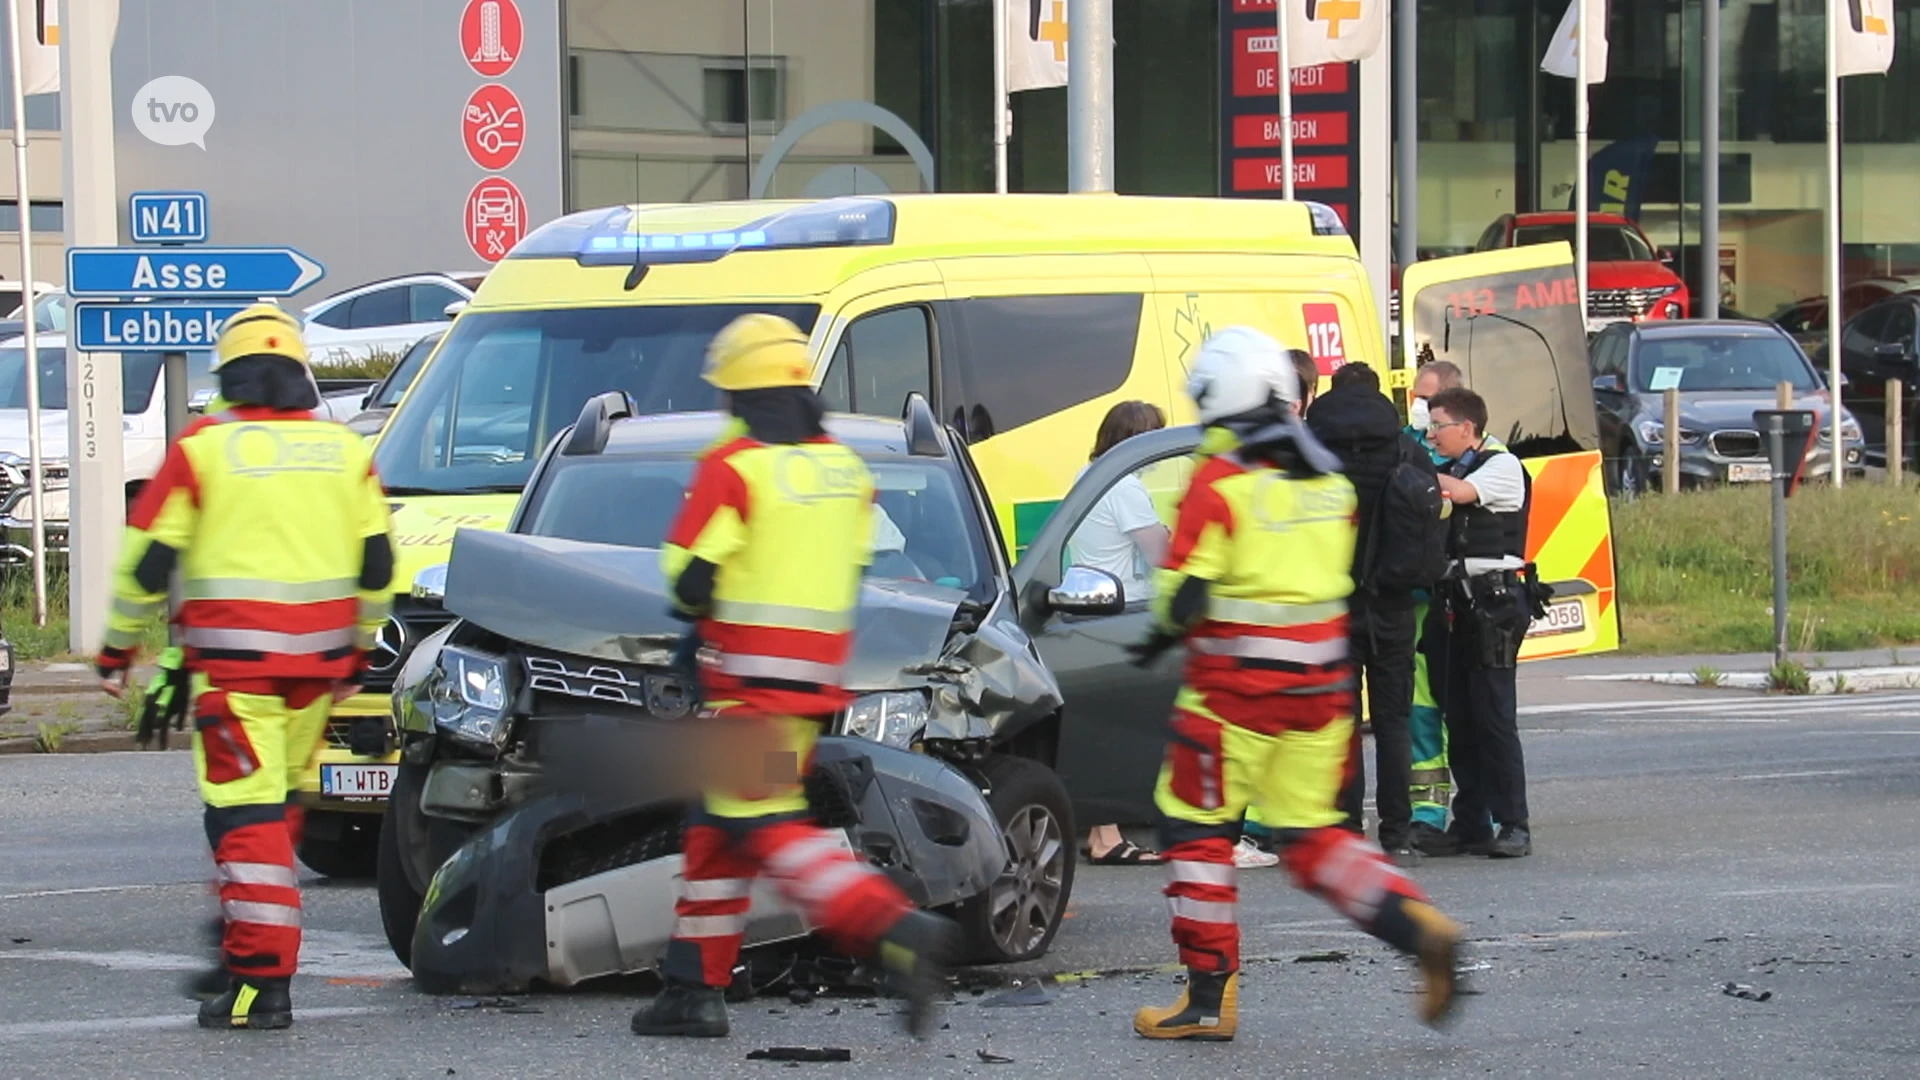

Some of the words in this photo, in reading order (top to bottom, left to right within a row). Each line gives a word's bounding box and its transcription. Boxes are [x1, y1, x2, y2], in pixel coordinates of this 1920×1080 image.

[1256, 68, 1275, 88] DE
[1286, 66, 1325, 87] MEDT
[1263, 119, 1317, 140] BADEN
[1265, 163, 1316, 184] VEGEN
[141, 200, 196, 235] N41
[131, 255, 227, 289] Asse
[1447, 287, 1497, 319] 112
[103, 310, 222, 344] Lebbek
[1308, 322, 1343, 358] 112
